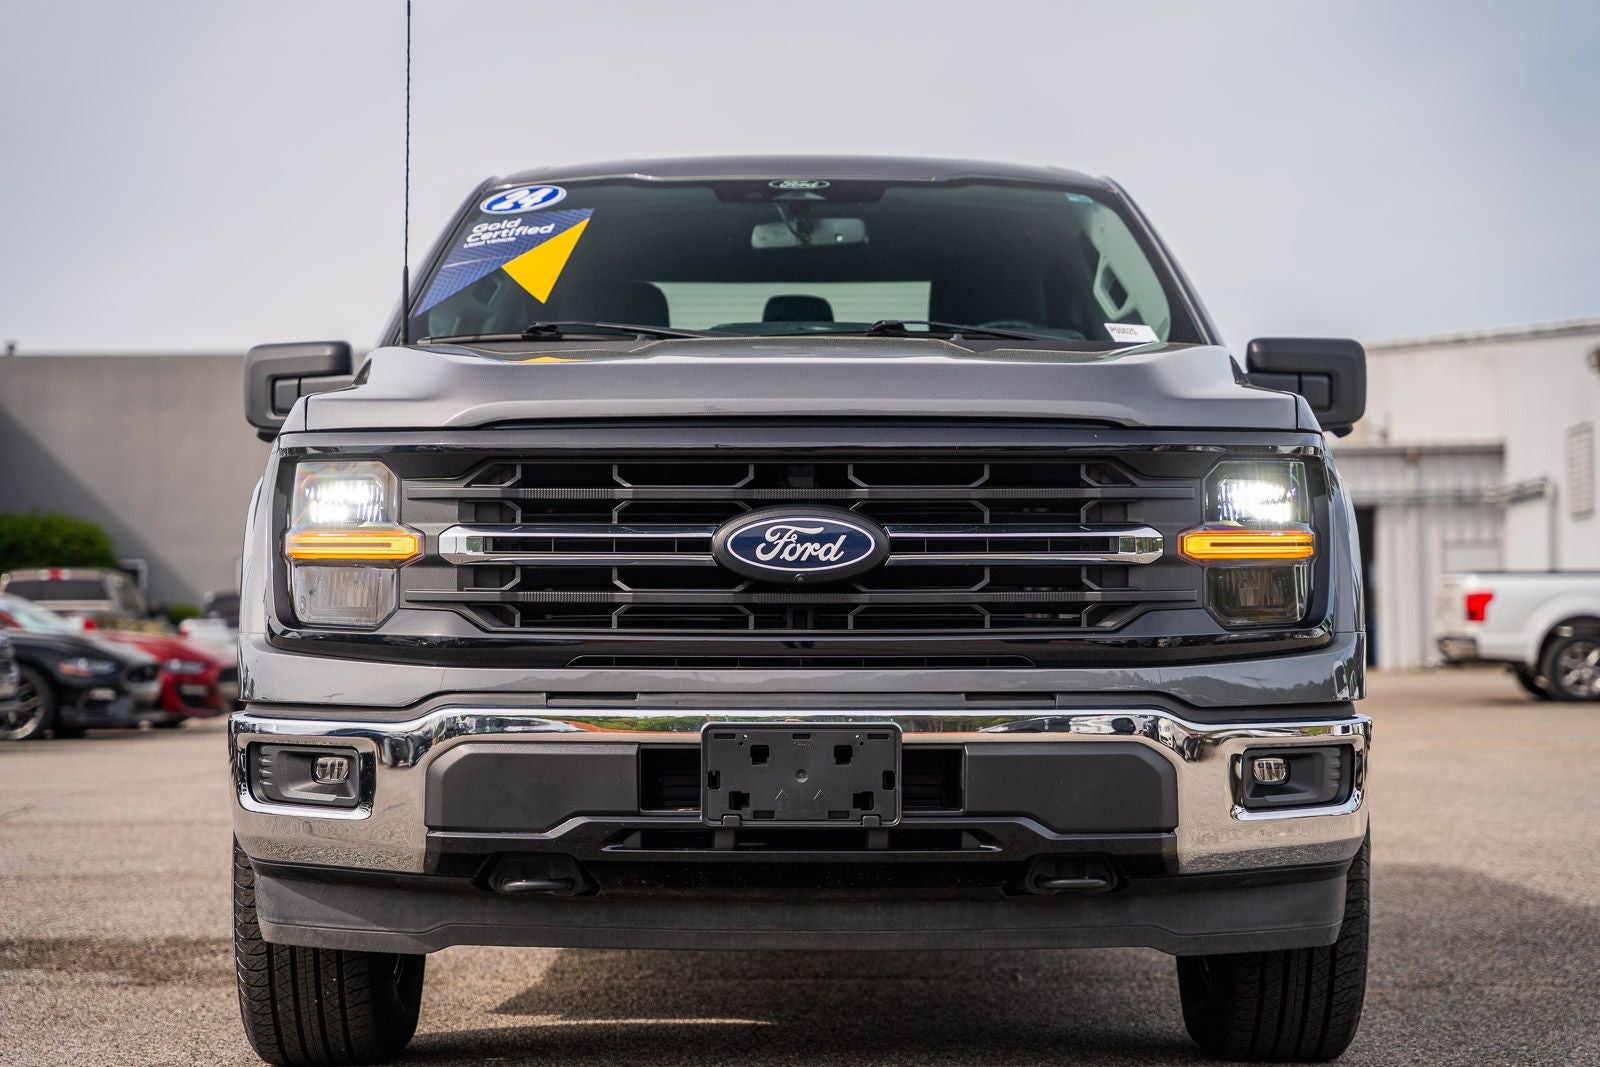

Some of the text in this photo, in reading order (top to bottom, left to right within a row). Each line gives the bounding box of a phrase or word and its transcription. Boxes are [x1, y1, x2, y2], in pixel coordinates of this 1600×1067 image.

[780, 180, 818, 188] Ford
[492, 187, 554, 211] 24
[466, 223, 555, 243] Certified
[472, 217, 522, 234] Gold
[755, 525, 847, 562] Ford
